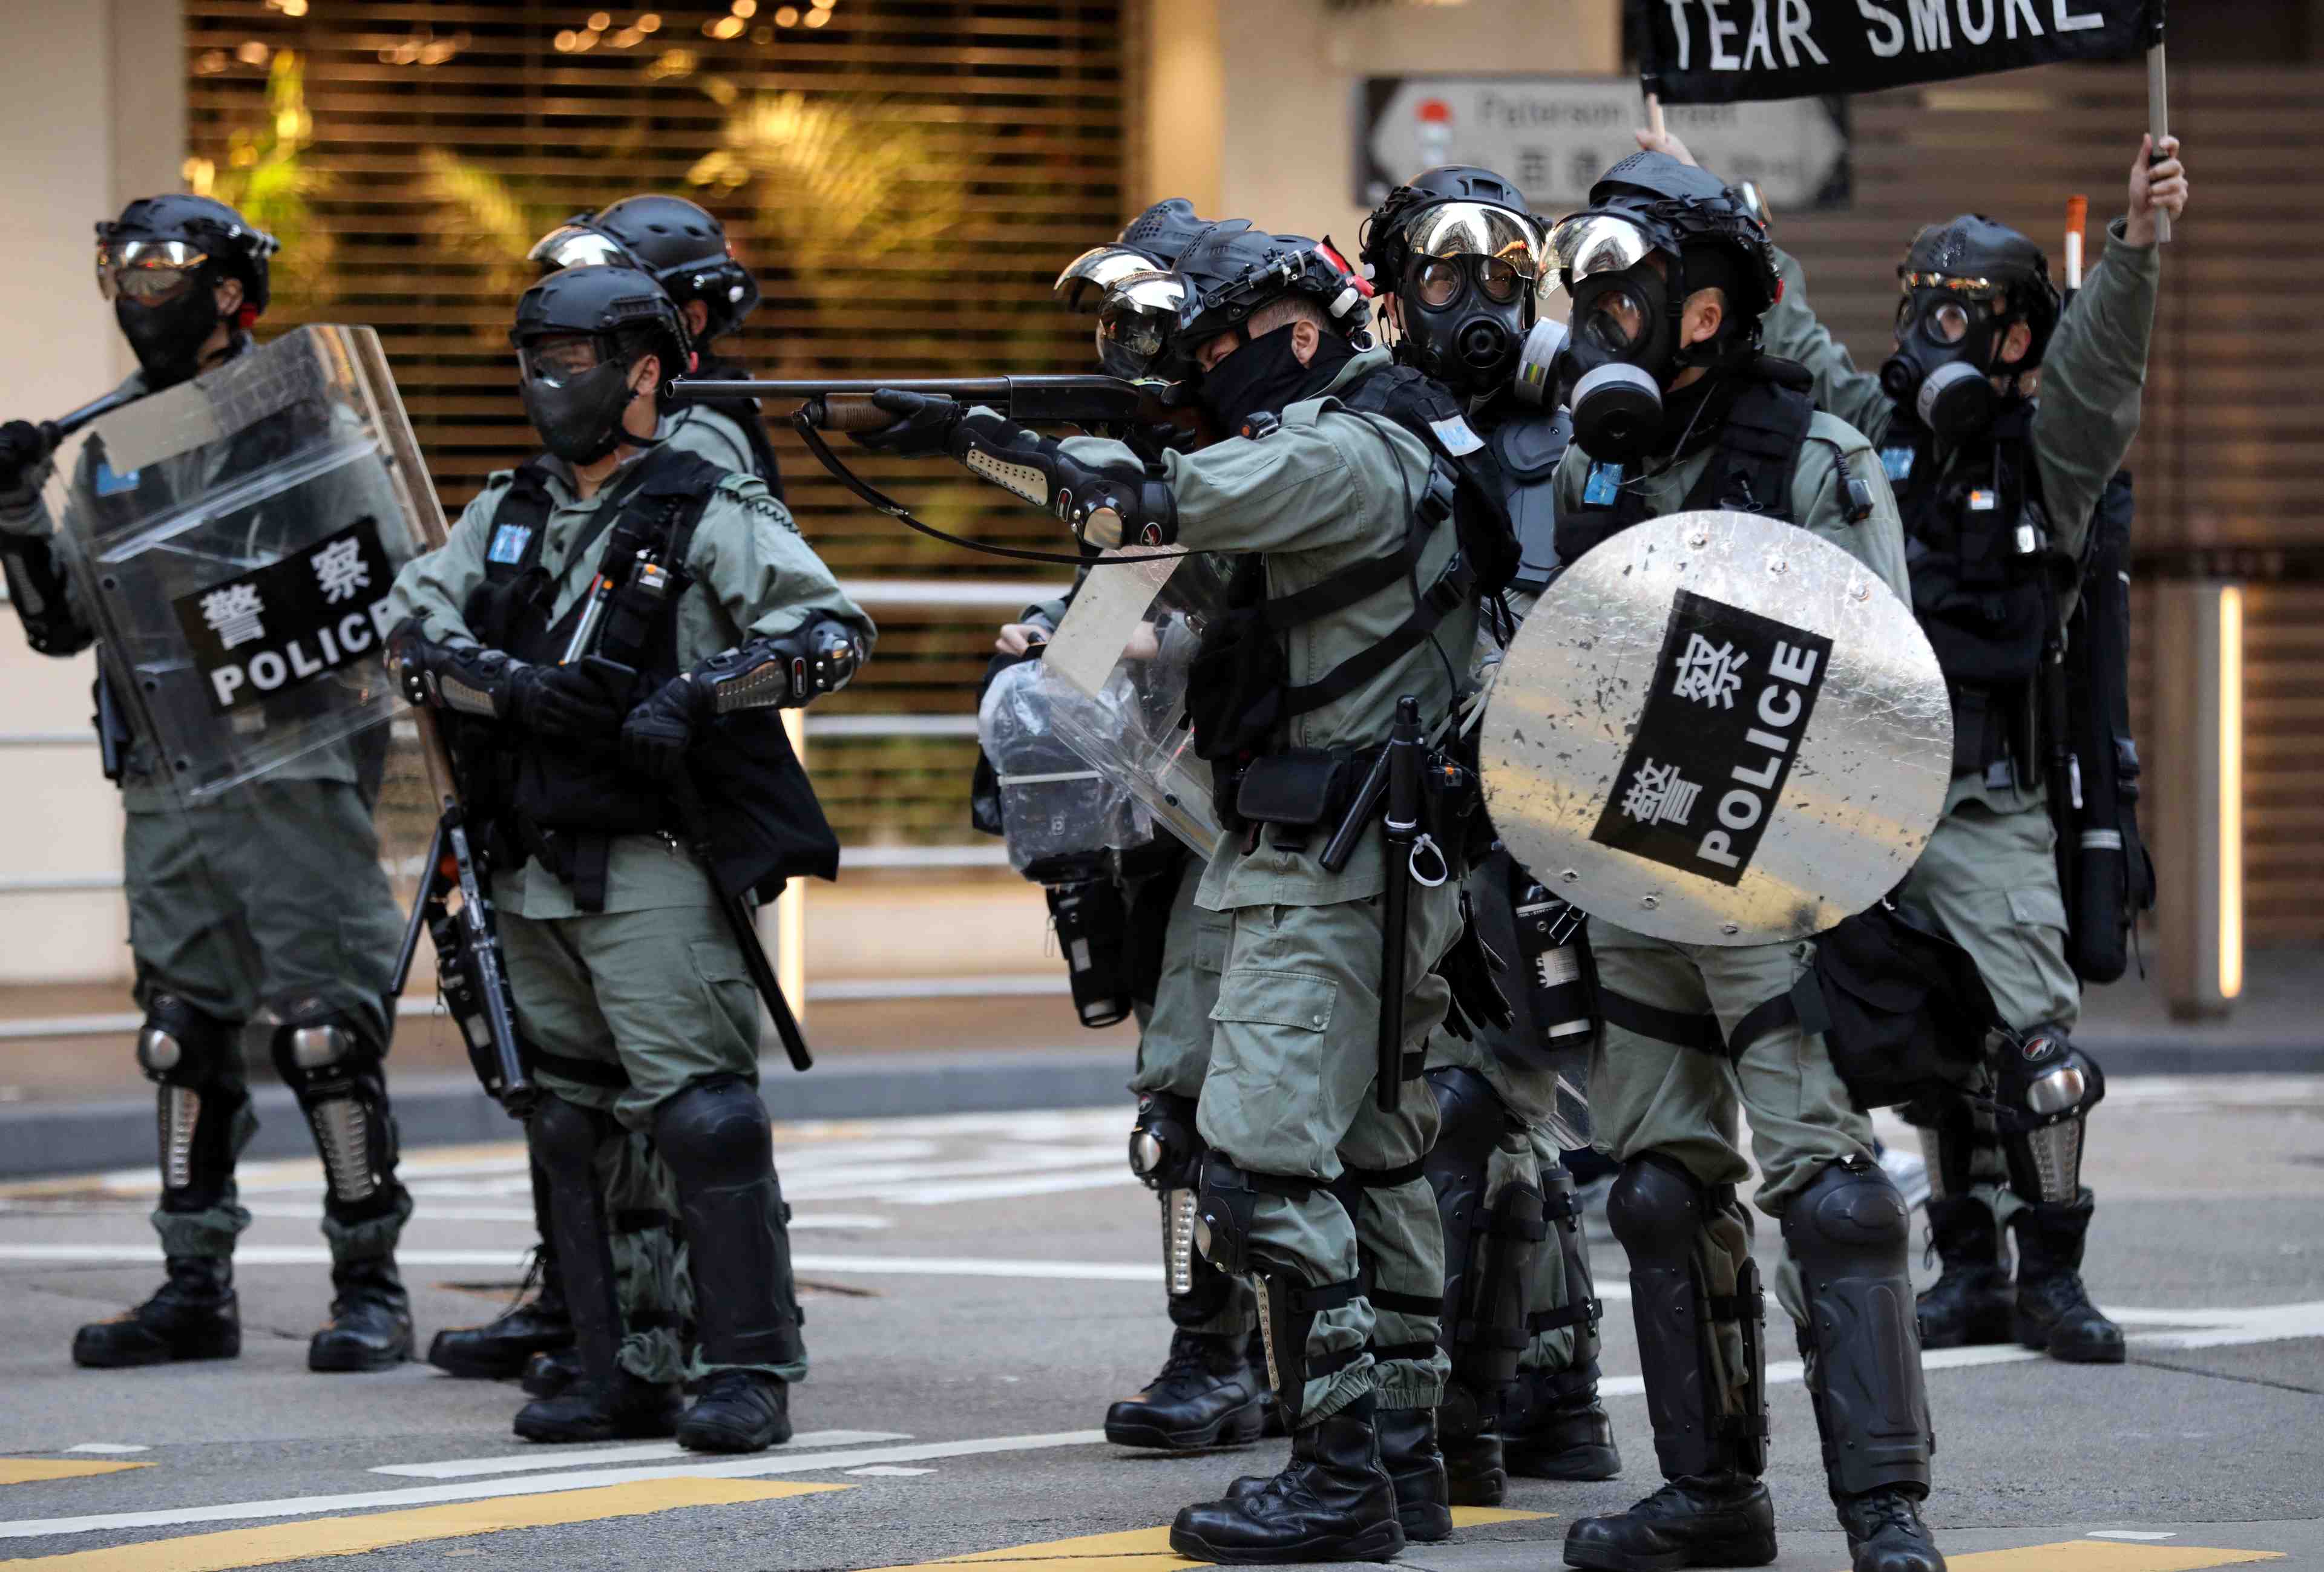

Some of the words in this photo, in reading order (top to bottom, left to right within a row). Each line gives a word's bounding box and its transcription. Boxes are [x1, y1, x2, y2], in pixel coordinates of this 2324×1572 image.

[1665, 0, 1830, 70] TEAR
[200, 538, 370, 649] 警察
[1622, 632, 1748, 826] 警察
[1696, 640, 1818, 868] POLICE
